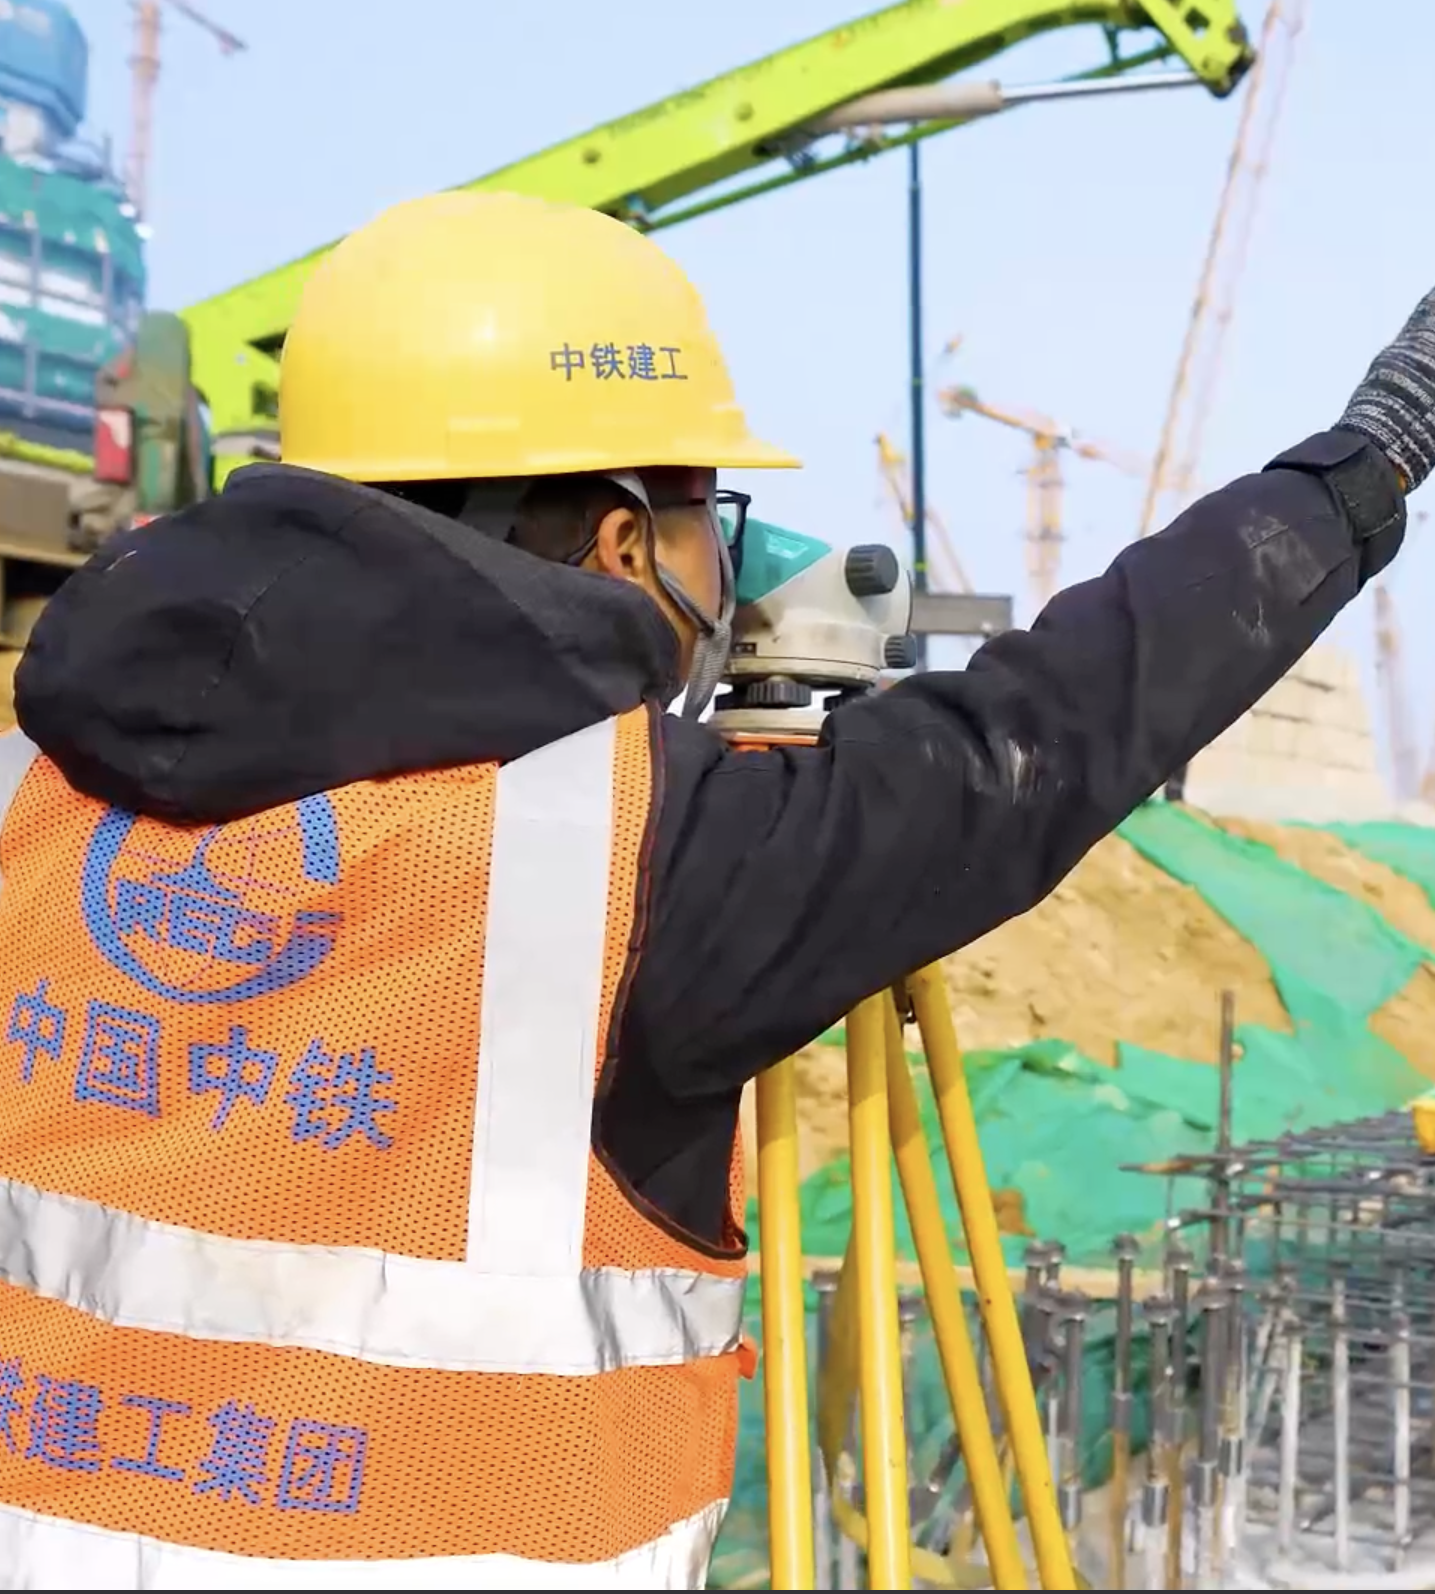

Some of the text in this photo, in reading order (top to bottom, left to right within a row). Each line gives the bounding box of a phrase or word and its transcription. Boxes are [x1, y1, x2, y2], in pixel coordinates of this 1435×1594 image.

[550, 342, 688, 382] 中铁建工
[6, 977, 398, 1151] 中国中铁
